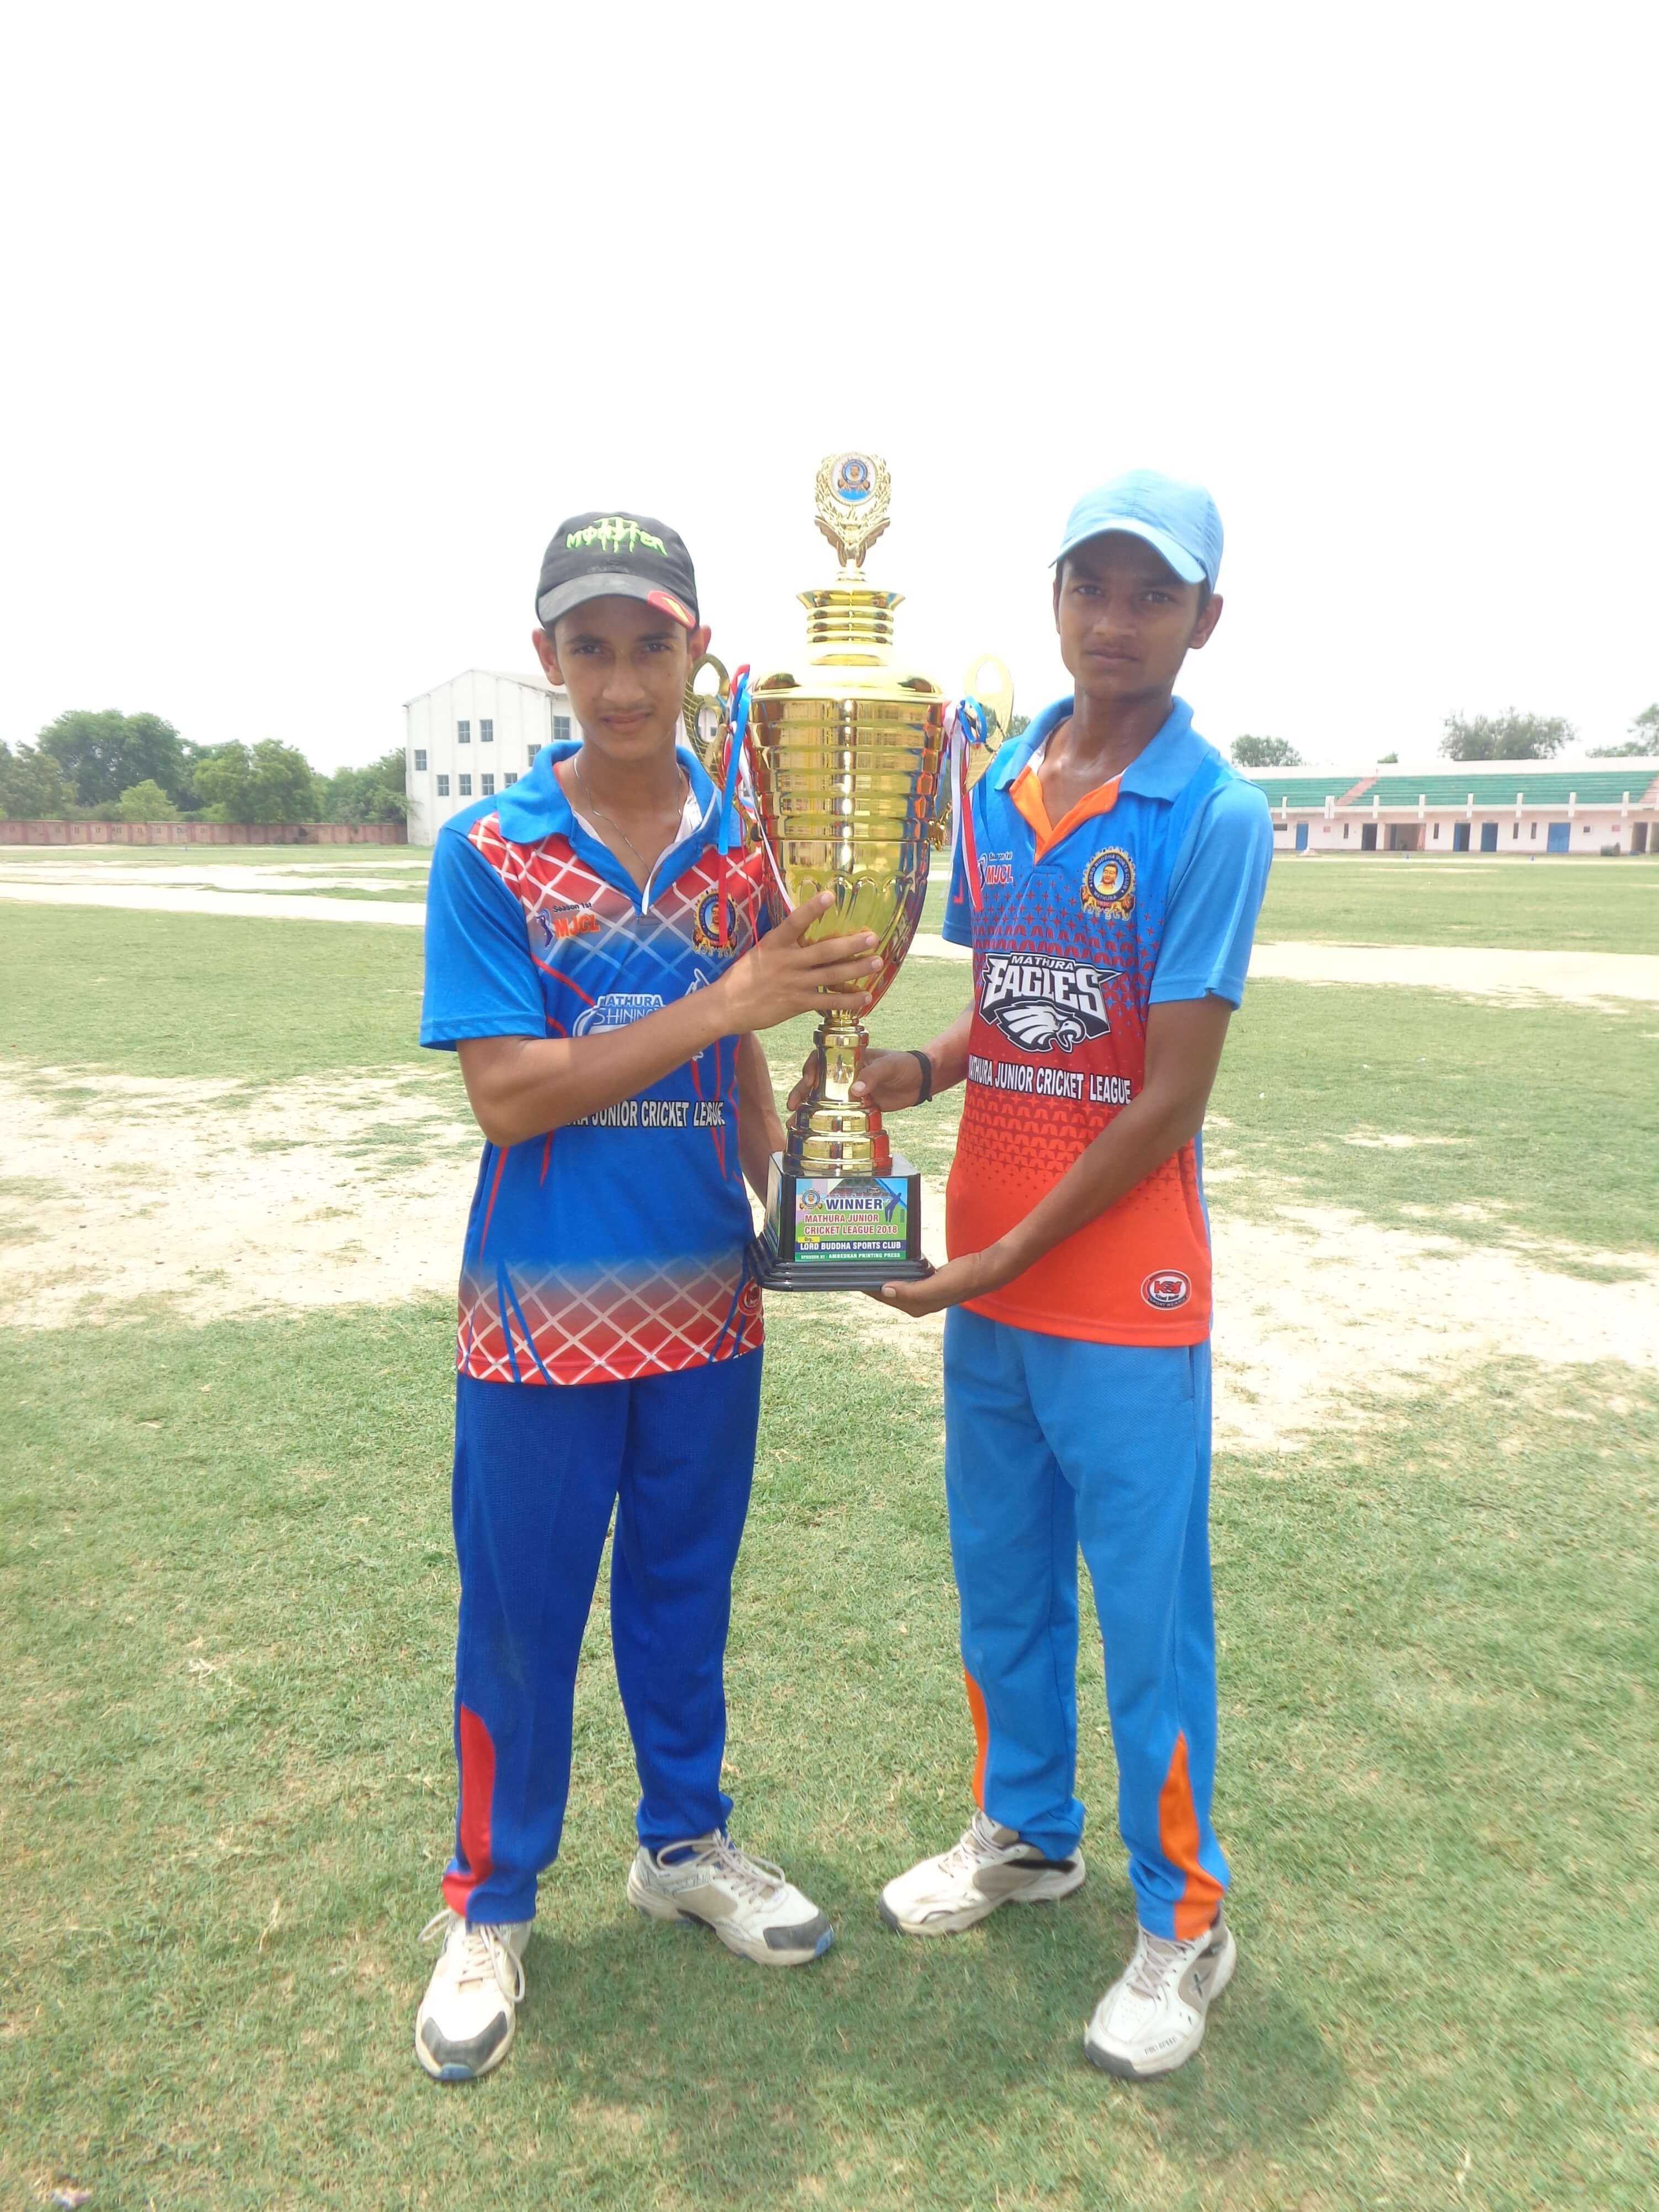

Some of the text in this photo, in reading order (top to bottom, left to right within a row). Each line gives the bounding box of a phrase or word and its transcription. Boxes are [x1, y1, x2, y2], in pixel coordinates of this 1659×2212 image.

[566, 516, 668, 556] MONSTER
[1095, 854, 1115, 867] BUDDHA
[986, 865, 1013, 884] MJCL
[1093, 891, 1117, 900] MATHURA
[553, 904, 579, 913] Season
[554, 914, 600, 939] MJCL
[1011, 955, 1074, 970] MATHURA
[983, 958, 1107, 1024] EAGLES
[995, 1063, 1033, 1092] JUNIOR
[1037, 1068, 1084, 1100] CRICKET
[1090, 1075, 1131, 1104] LEAGUE
[641, 1101, 689, 1127] CRICKET
[826, 1198, 883, 1210] WINNER
[805, 1214, 878, 1223] MATHURA JUNIOR
